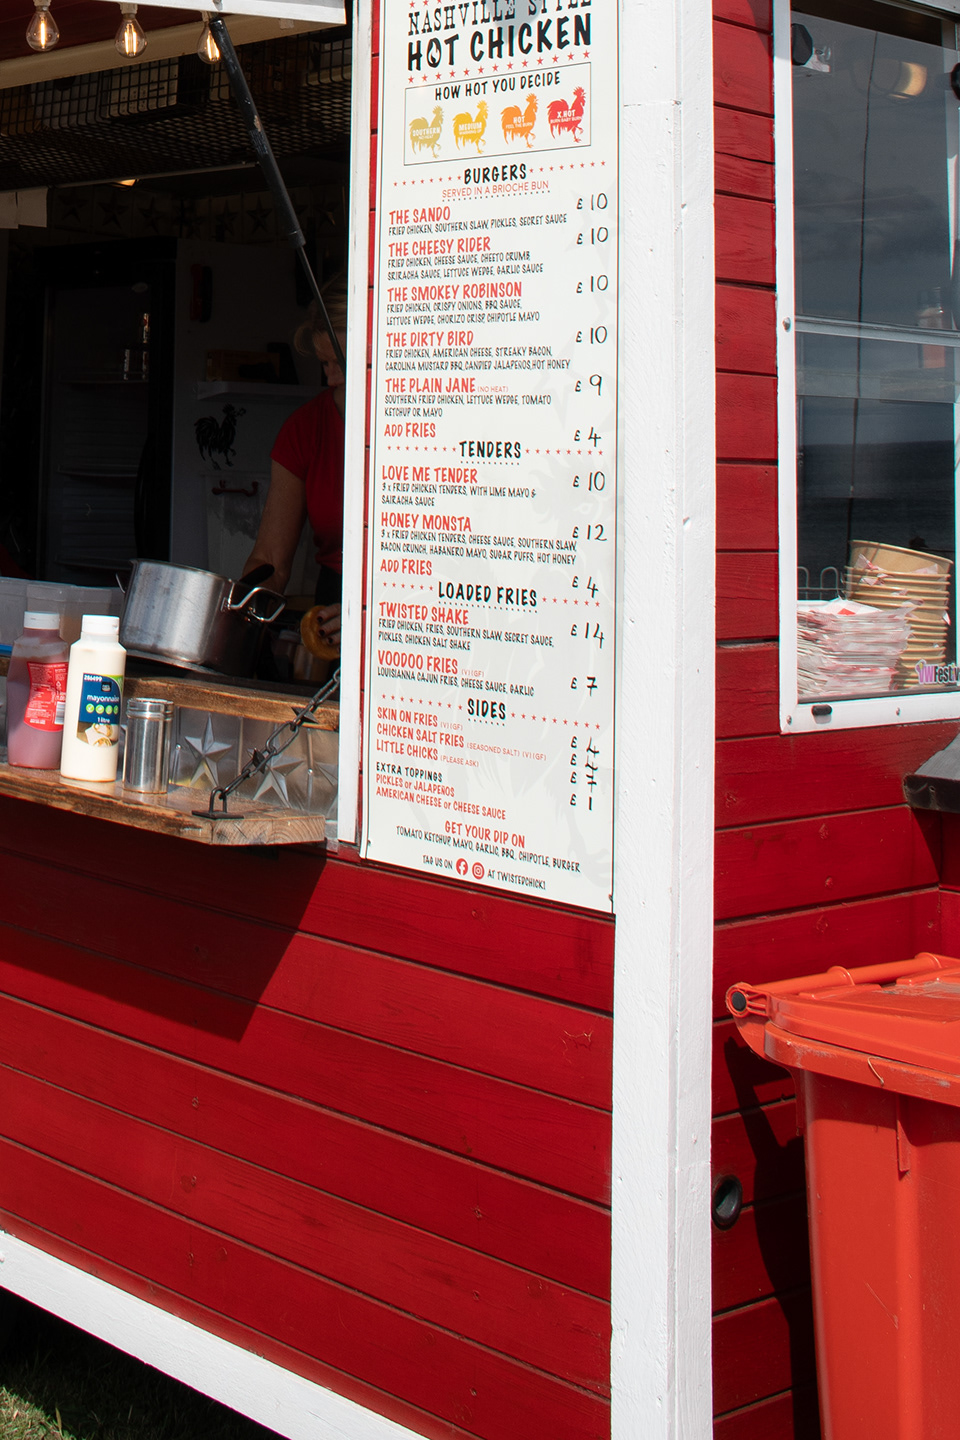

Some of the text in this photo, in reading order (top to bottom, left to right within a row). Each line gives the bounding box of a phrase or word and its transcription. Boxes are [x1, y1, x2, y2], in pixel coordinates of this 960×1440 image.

[408, 13, 591, 70] HOT CHICKEN
[435, 71, 560, 100] HOW HOT YOU DECIDE
[458, 122, 482, 130] MEDIUM
[464, 164, 527, 184] BURGERS
[442, 181, 548, 198] SERVED IN A BRIOCHE BUN
[390, 193, 607, 224] THE SANDO £ 10
[389, 226, 405, 235] FRIED
[435, 221, 468, 232] SOUTHERN
[491, 218, 517, 228] PICKLES,
[520, 216, 543, 226] SECRET
[546, 214, 567, 224] SAUCE
[389, 227, 608, 256] THE CHEESY RIDER £ 10
[388, 275, 608, 302] THE SMOKEY ROBINSON £ 10
[386, 326, 607, 347] THE DIRTY BIRD £ 10
[386, 374, 602, 396] THE PLAIN JANE £ 9
[384, 423, 601, 447] ADD FRIES £ 4
[460, 441, 521, 458] TENDERS
[383, 466, 605, 491] LOVE ME TENDER £ 10
[381, 513, 607, 541] HONEY MONSTA £ 12
[381, 559, 598, 598] ADD FRIES £ 4
[439, 581, 537, 606] LOADED FRIES
[379, 602, 604, 648] TWISTED SHAKE £ 14
[378, 650, 597, 696] VOODOO FRIES £ 7
[468, 698, 506, 719] SIDES
[377, 723, 464, 748] CHICKEN SALT FRIES
[378, 707, 599, 756] SKIN ON FRIES £ 4
[377, 739, 438, 761] LITTLE CHICKS
[377, 762, 442, 783] EXTRA TOPPINGS
[377, 774, 403, 789] PICKLES
[405, 779, 411, 790] or
[570, 794, 576, 805] £
[589, 797, 592, 810] 1
[377, 787, 506, 820] AMERICAN CHEESE or CHEESE SAUCE
[445, 821, 525, 848] GET YOUR DIP ON
[397, 826, 423, 840] TOMATO
[553, 857, 580, 872] BURGER
[423, 855, 432, 866] TAG
[435, 857, 443, 868] US
[444, 859, 453, 869] ON
[488, 869, 494, 879] AT
